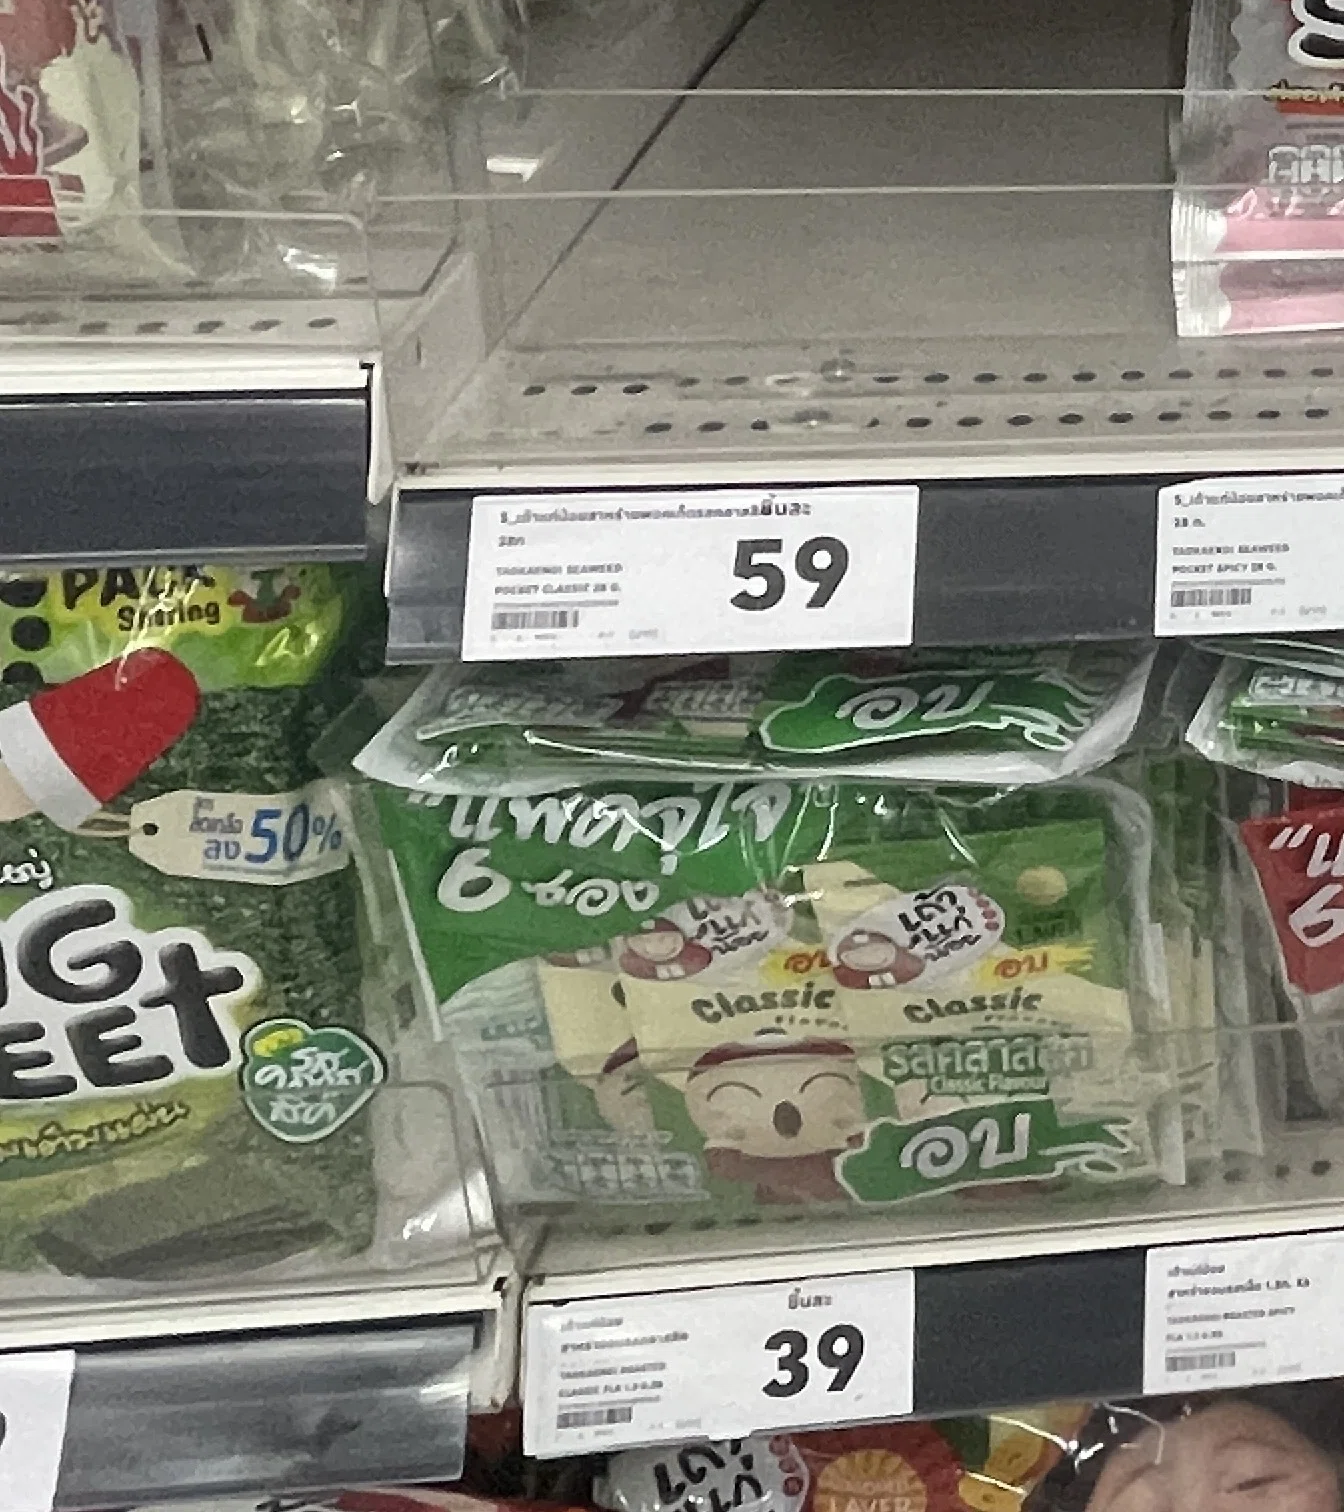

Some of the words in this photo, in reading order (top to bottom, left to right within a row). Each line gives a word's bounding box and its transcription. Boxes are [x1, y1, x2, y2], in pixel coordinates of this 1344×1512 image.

[729, 535, 850, 612] 59
[437, 845, 512, 912] 6
[0, 896, 143, 1007] G
[690, 980, 838, 1025] Classic
[902, 984, 1045, 1025] Classic
[899, 1108, 1034, 1179] อบ
[761, 1322, 865, 1399] 39
